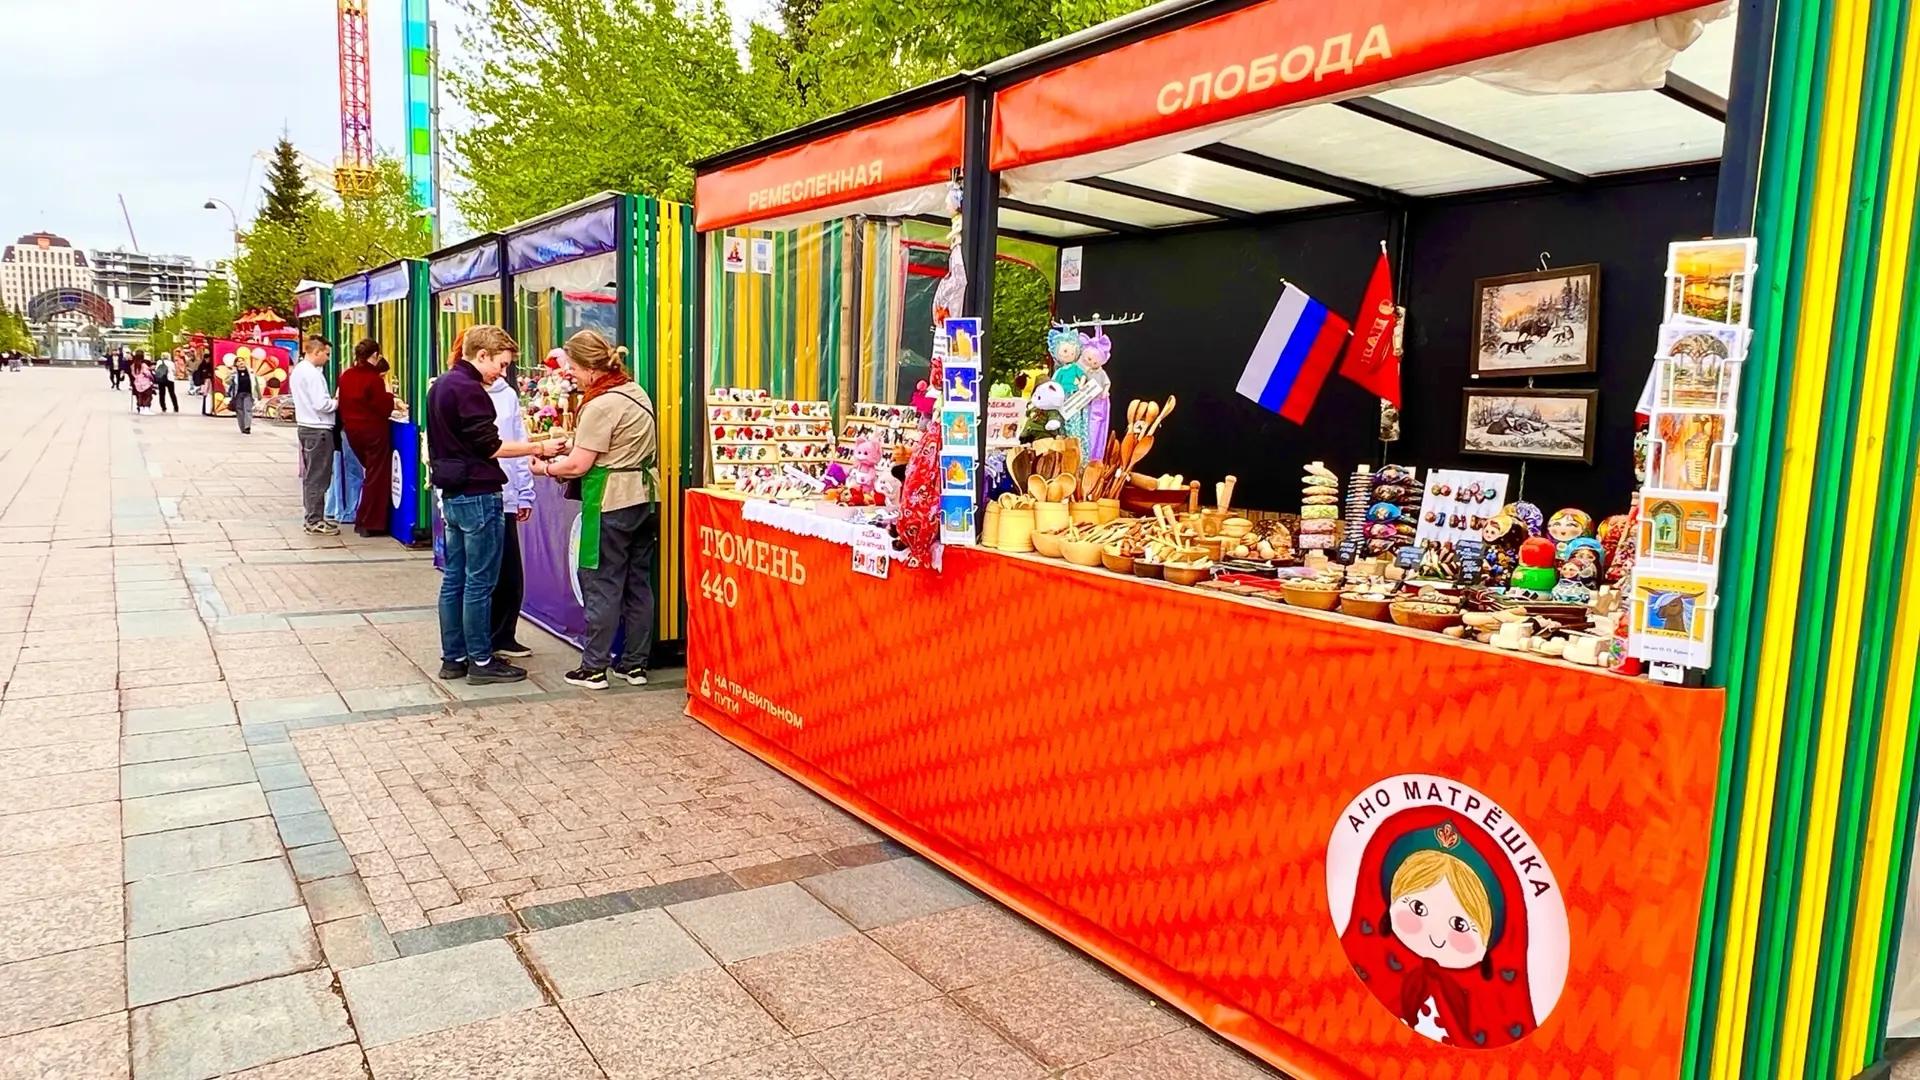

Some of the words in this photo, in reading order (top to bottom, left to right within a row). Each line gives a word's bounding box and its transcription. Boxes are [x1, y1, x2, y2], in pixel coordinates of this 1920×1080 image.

[1156, 23, 1393, 116] СЛОБОДА
[748, 159, 884, 212] РЕМЕСЛЕННАЯ
[699, 525, 807, 587] ТЮМЕНЬ
[700, 569, 739, 609] 440
[713, 691, 741, 715] ПУТИ
[714, 674, 728, 691] НА
[729, 680, 804, 730] ПРАВИЛЬНОМ
[1347, 788, 1391, 833] АНО
[1403, 781, 1551, 898] МАТРЁШКА
